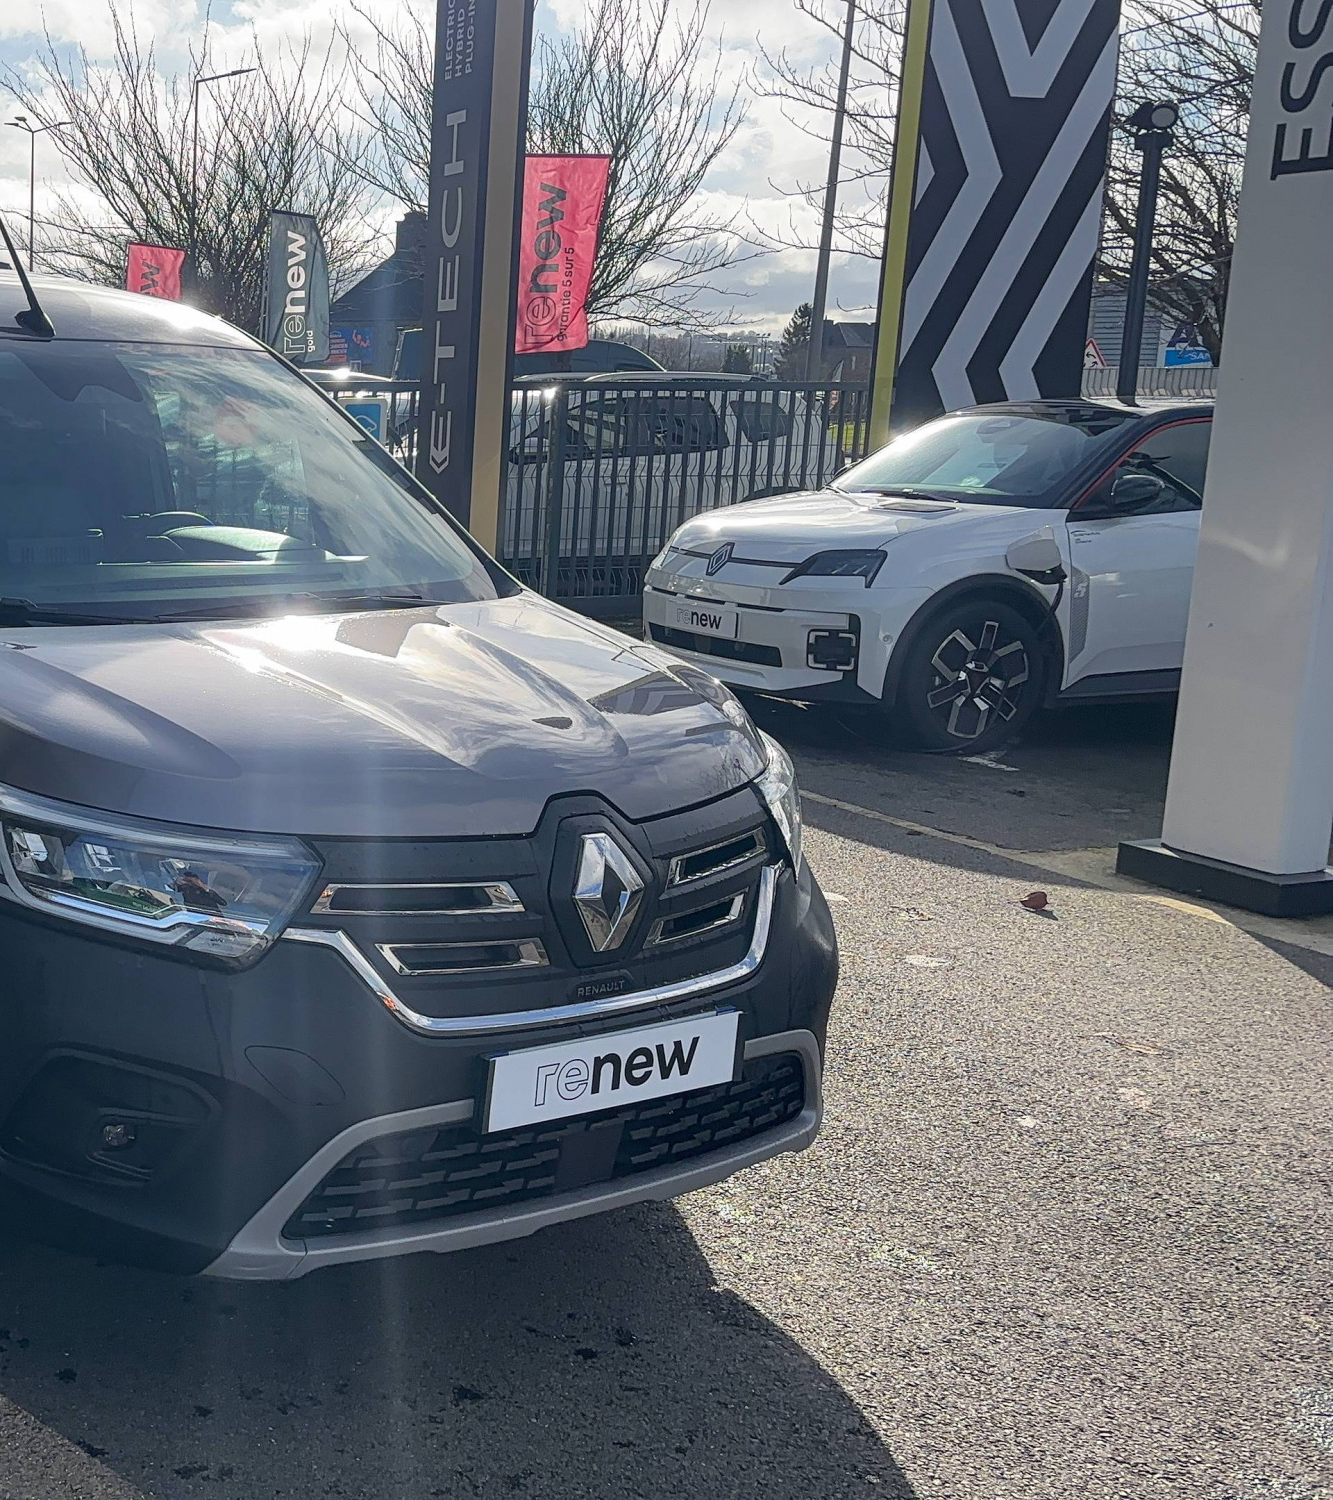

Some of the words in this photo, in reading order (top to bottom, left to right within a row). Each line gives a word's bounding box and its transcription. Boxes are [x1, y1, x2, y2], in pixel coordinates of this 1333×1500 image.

[445, 0, 455, 80] ELECTRIC
[455, 8, 465, 78] HYBRID
[465, 0, 476, 74] PLUG-IN
[140, 261, 160, 293] w
[524, 182, 567, 344] renew
[565, 247, 575, 255] 5
[565, 258, 574, 277] sur
[284, 230, 307, 354] renew
[430, 109, 467, 474] E-TECH
[563, 278, 572, 287] 5
[307, 330, 316, 352] gold
[557, 290, 572, 342] garantie
[676, 607, 722, 630] renew
[577, 980, 625, 997] RENAULT
[534, 1035, 701, 1107] renew
